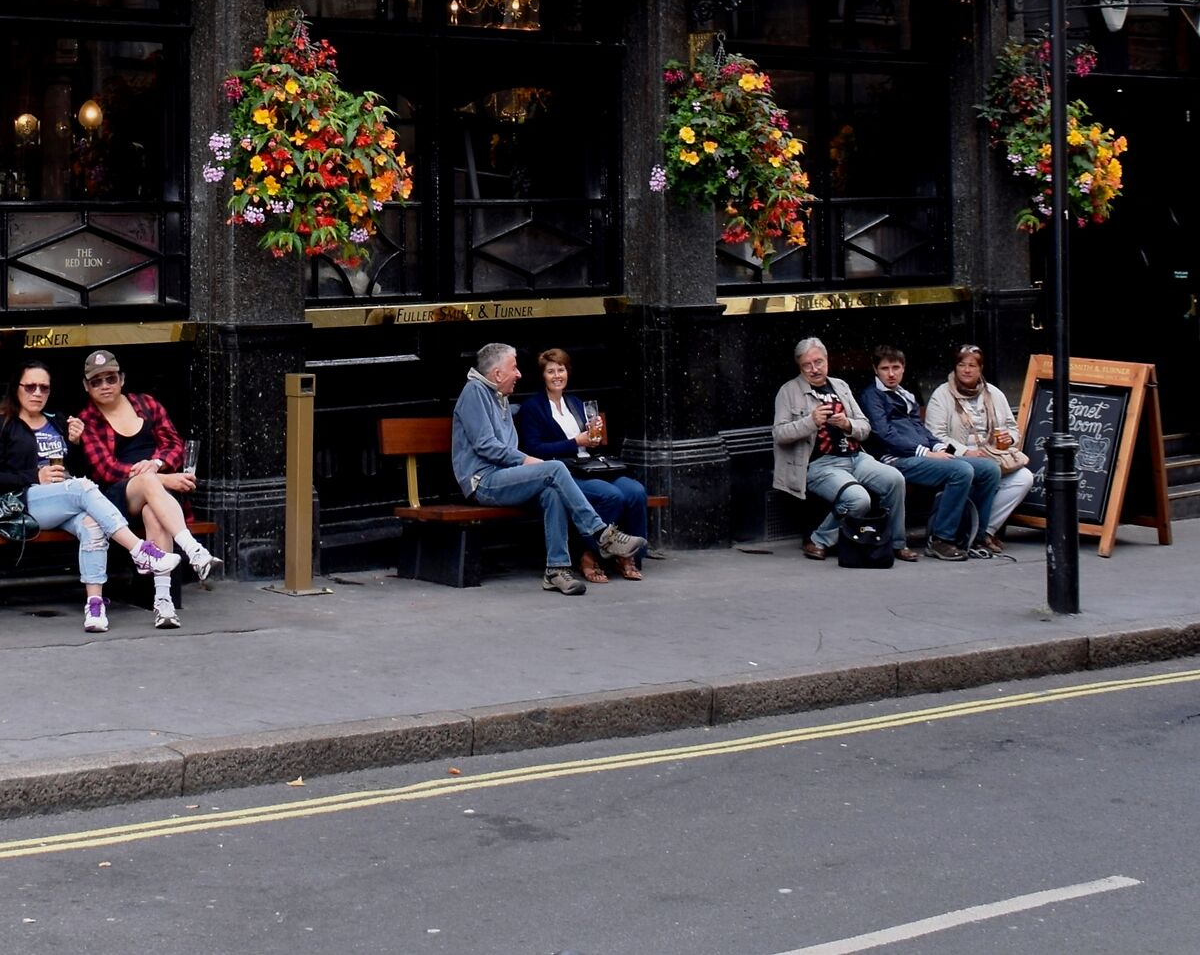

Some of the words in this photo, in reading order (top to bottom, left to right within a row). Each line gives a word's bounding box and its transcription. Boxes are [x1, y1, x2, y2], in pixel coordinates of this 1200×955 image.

[77, 248, 93, 258] THE
[65, 258, 81, 268] RED
[84, 258, 103, 267] LION
[397, 308, 434, 322] FULLER
[478, 304, 489, 318] &
[494, 304, 533, 318] TURNER
